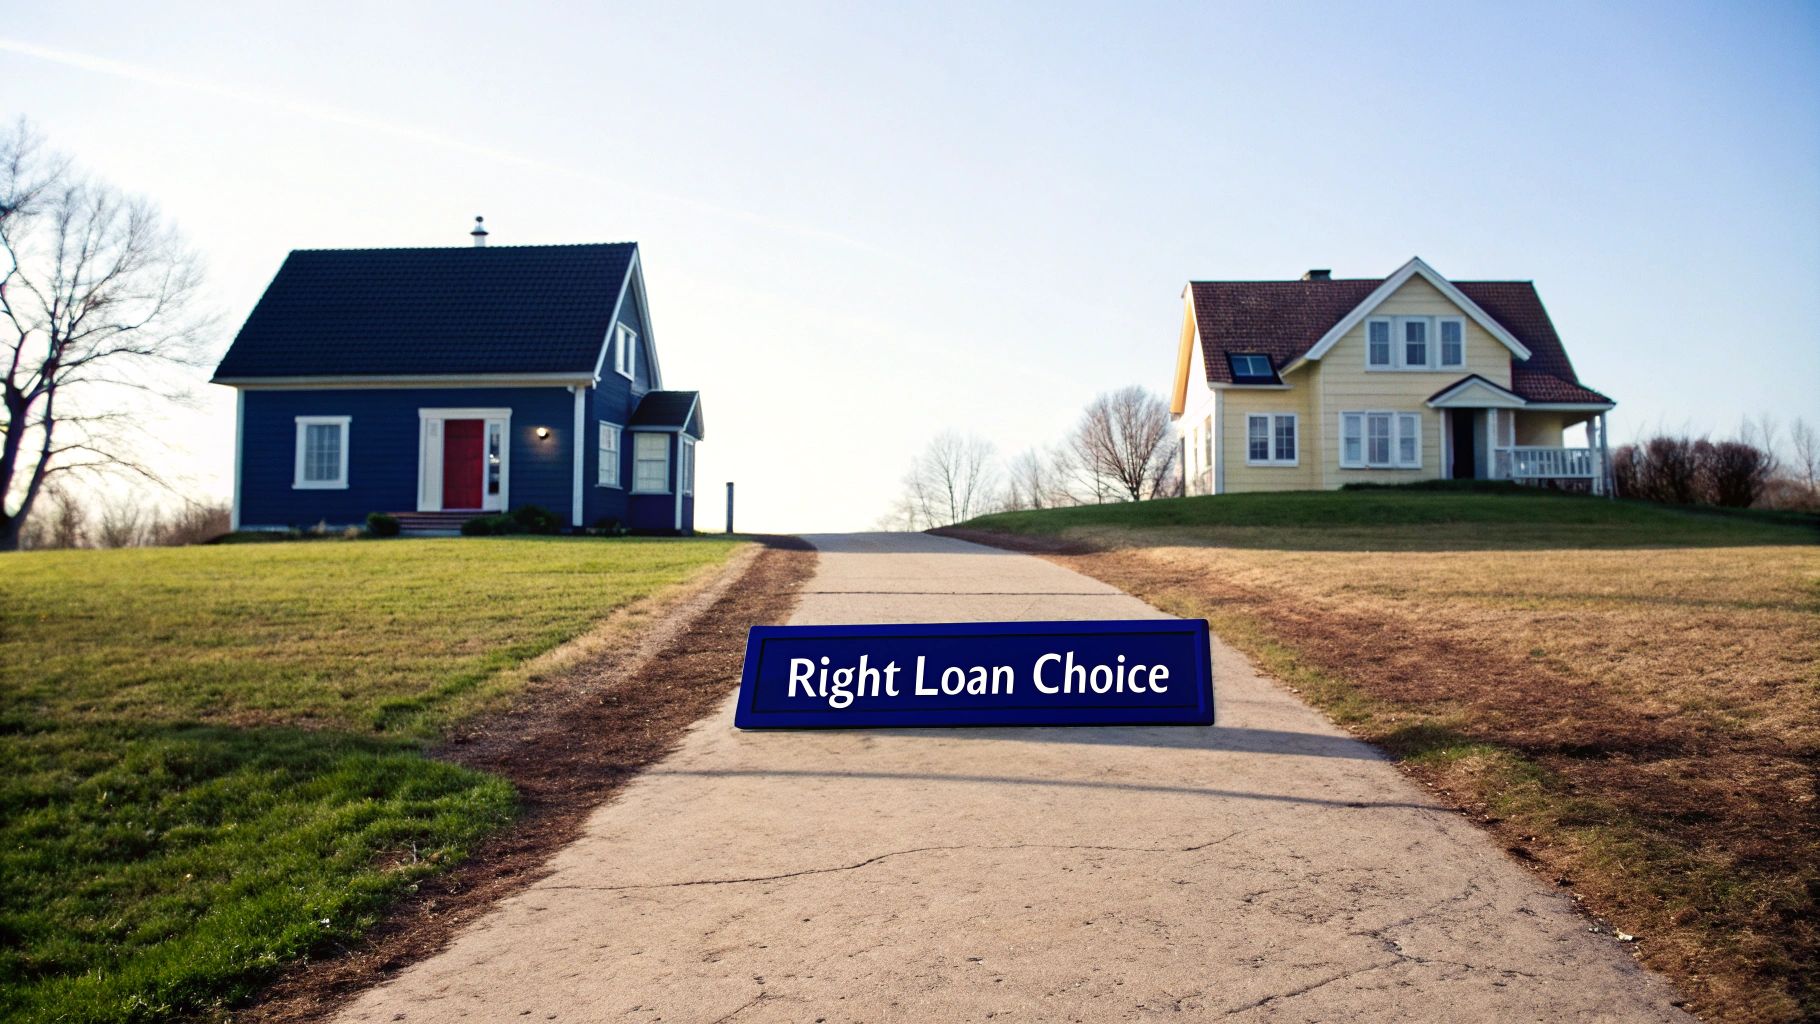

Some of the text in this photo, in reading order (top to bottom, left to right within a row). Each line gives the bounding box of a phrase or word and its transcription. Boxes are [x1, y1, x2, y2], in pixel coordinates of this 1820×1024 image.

[788, 650, 1170, 709] Right Loan Choice
